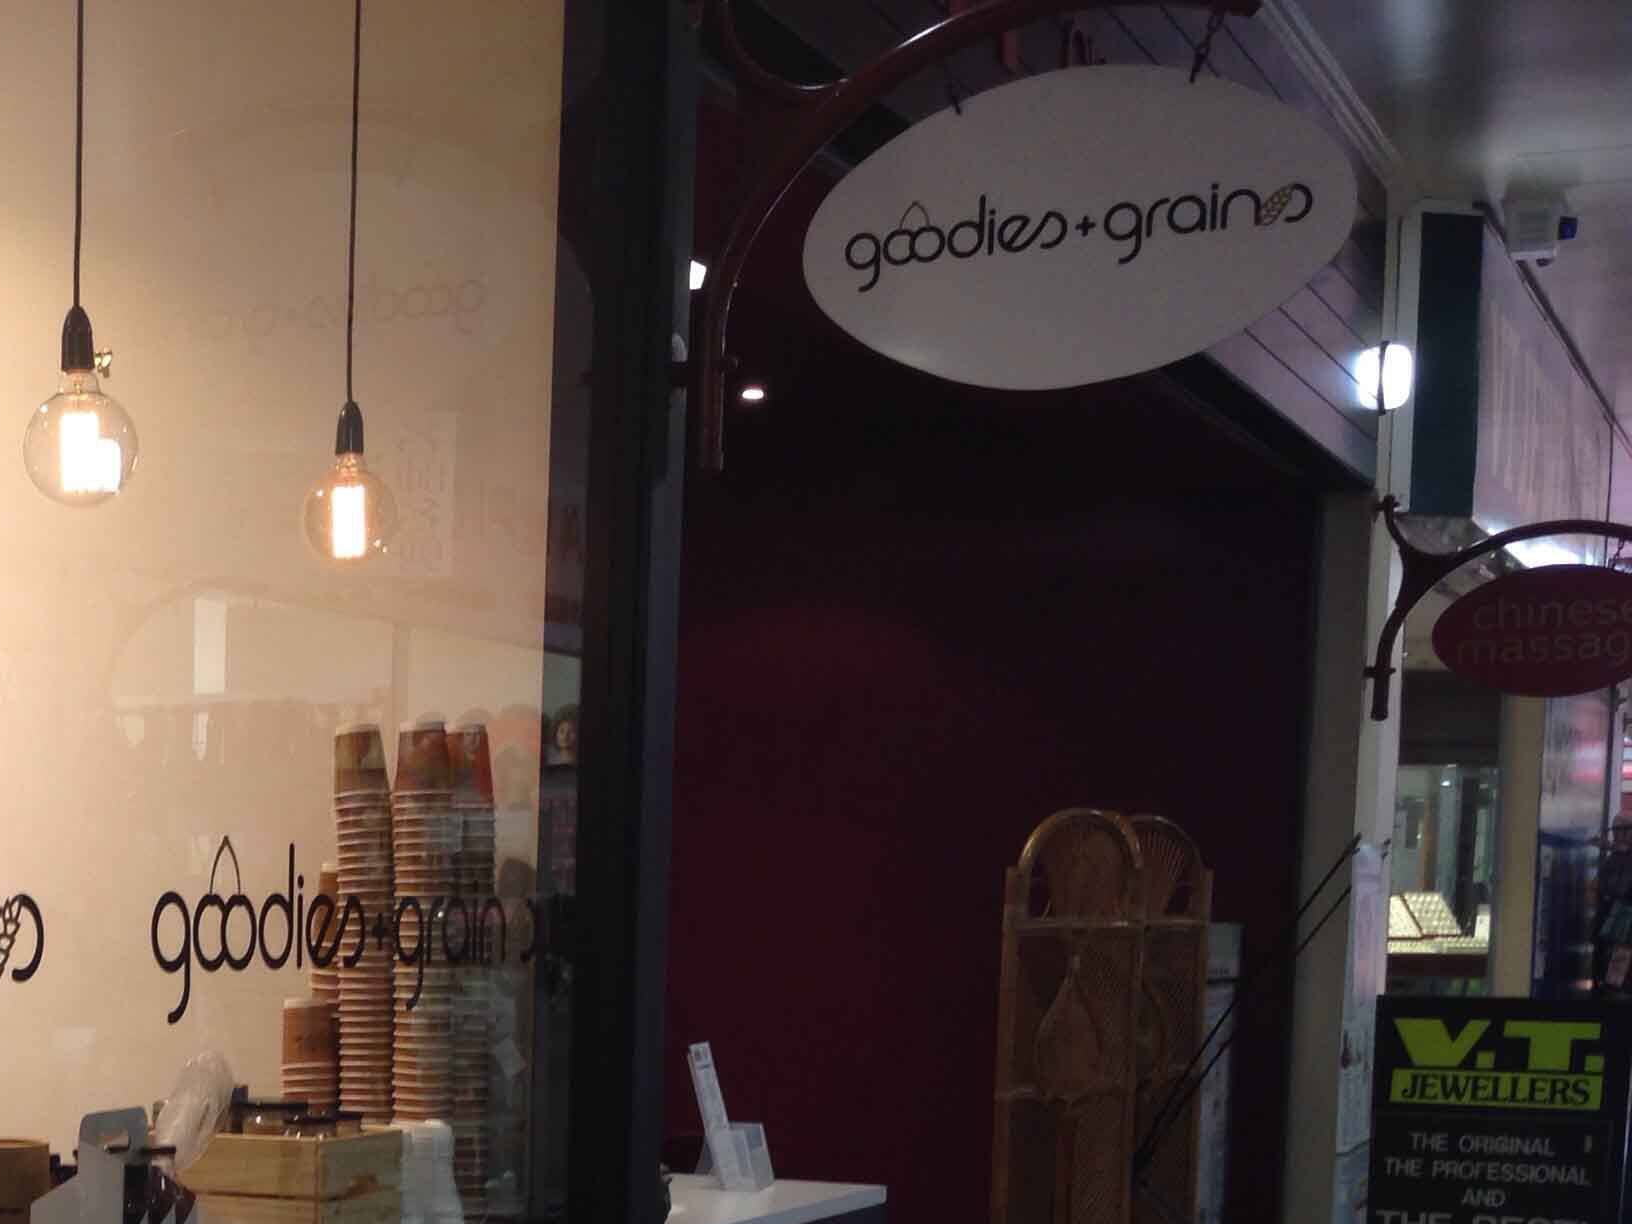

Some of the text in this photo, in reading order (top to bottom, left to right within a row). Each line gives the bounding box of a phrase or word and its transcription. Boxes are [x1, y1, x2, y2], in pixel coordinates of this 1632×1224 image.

[1456, 634, 1632, 666] massag
[1401, 1073, 1591, 1106] JEWELLERS
[1409, 1131, 1557, 1158] THE ORIGINAL
[1383, 1156, 1593, 1186] THE PROFESSIONAL
[1461, 1188, 1507, 1209] AND
